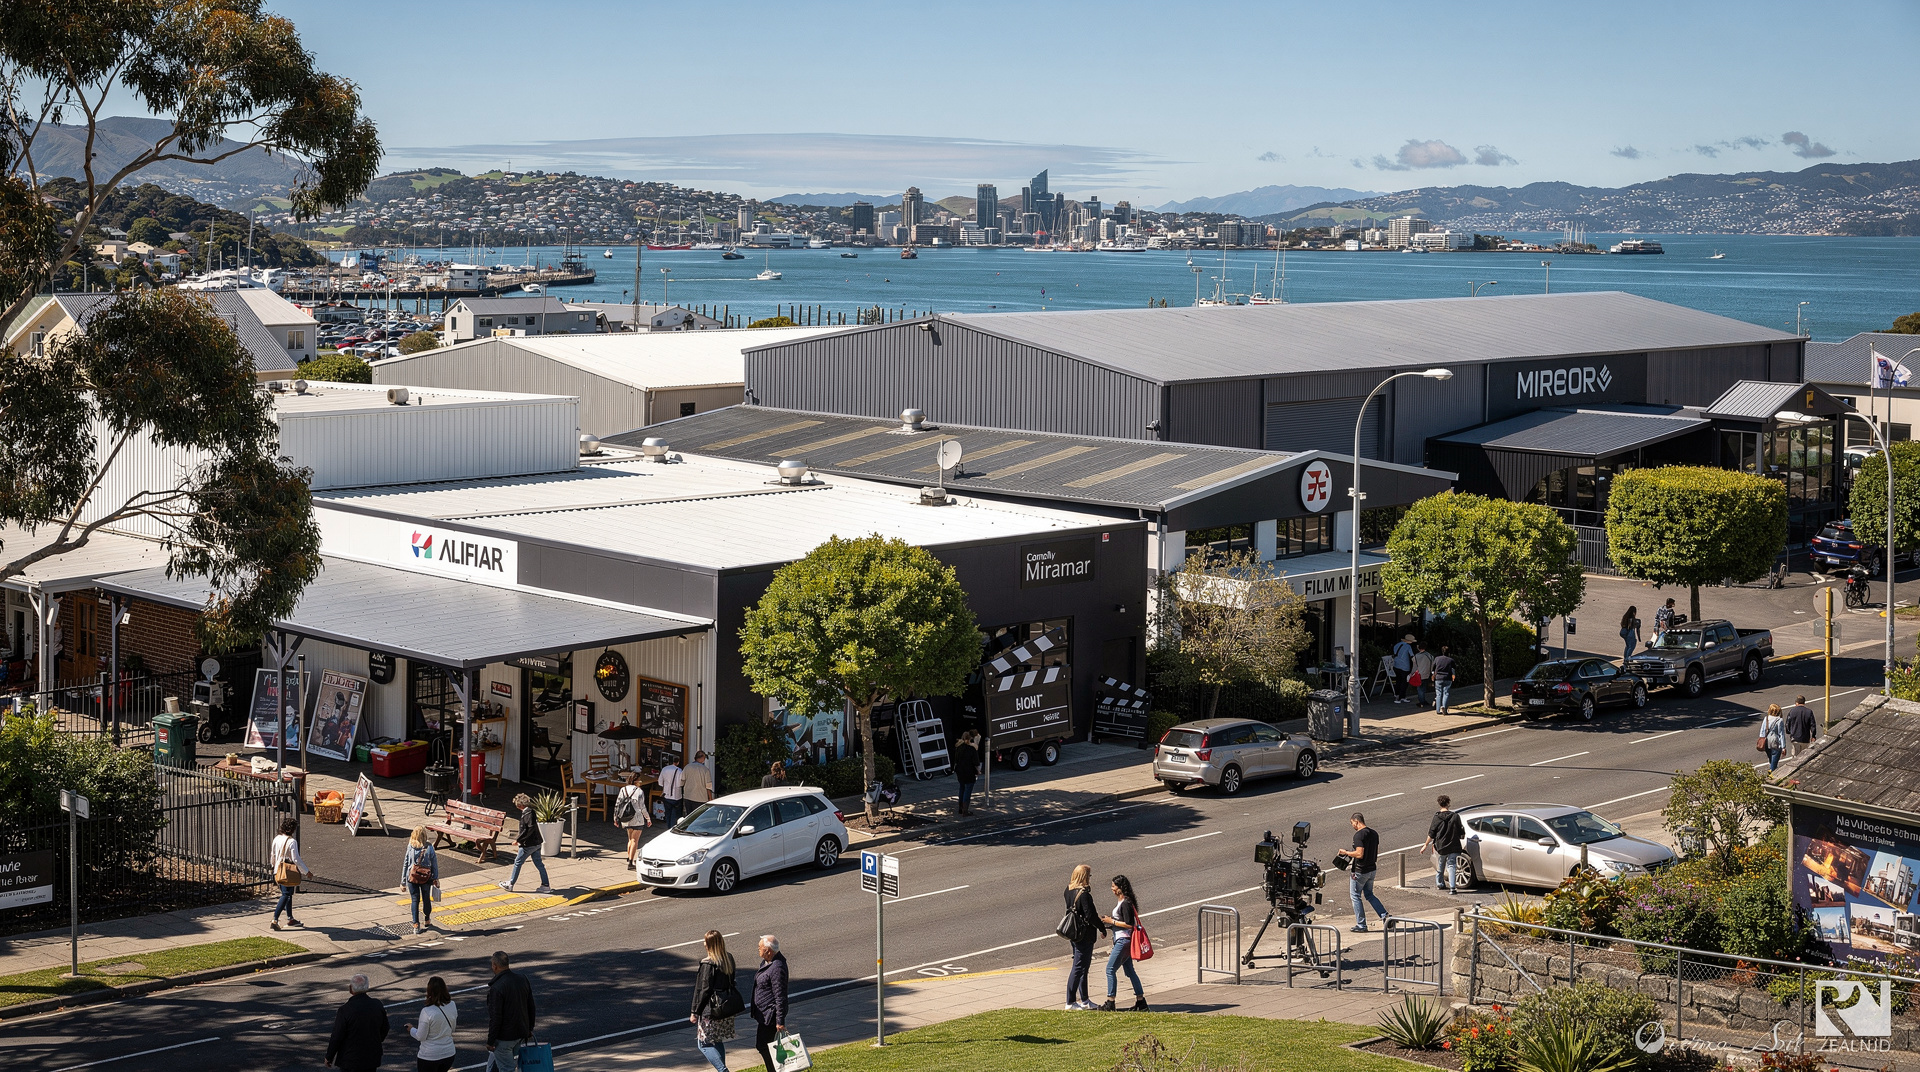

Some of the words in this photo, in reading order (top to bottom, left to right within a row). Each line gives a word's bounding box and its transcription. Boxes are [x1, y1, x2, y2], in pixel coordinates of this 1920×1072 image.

[438, 539, 504, 573] ALIFIAR
[1026, 559, 1091, 582] Miramar
[1305, 577, 1335, 596] FILM
